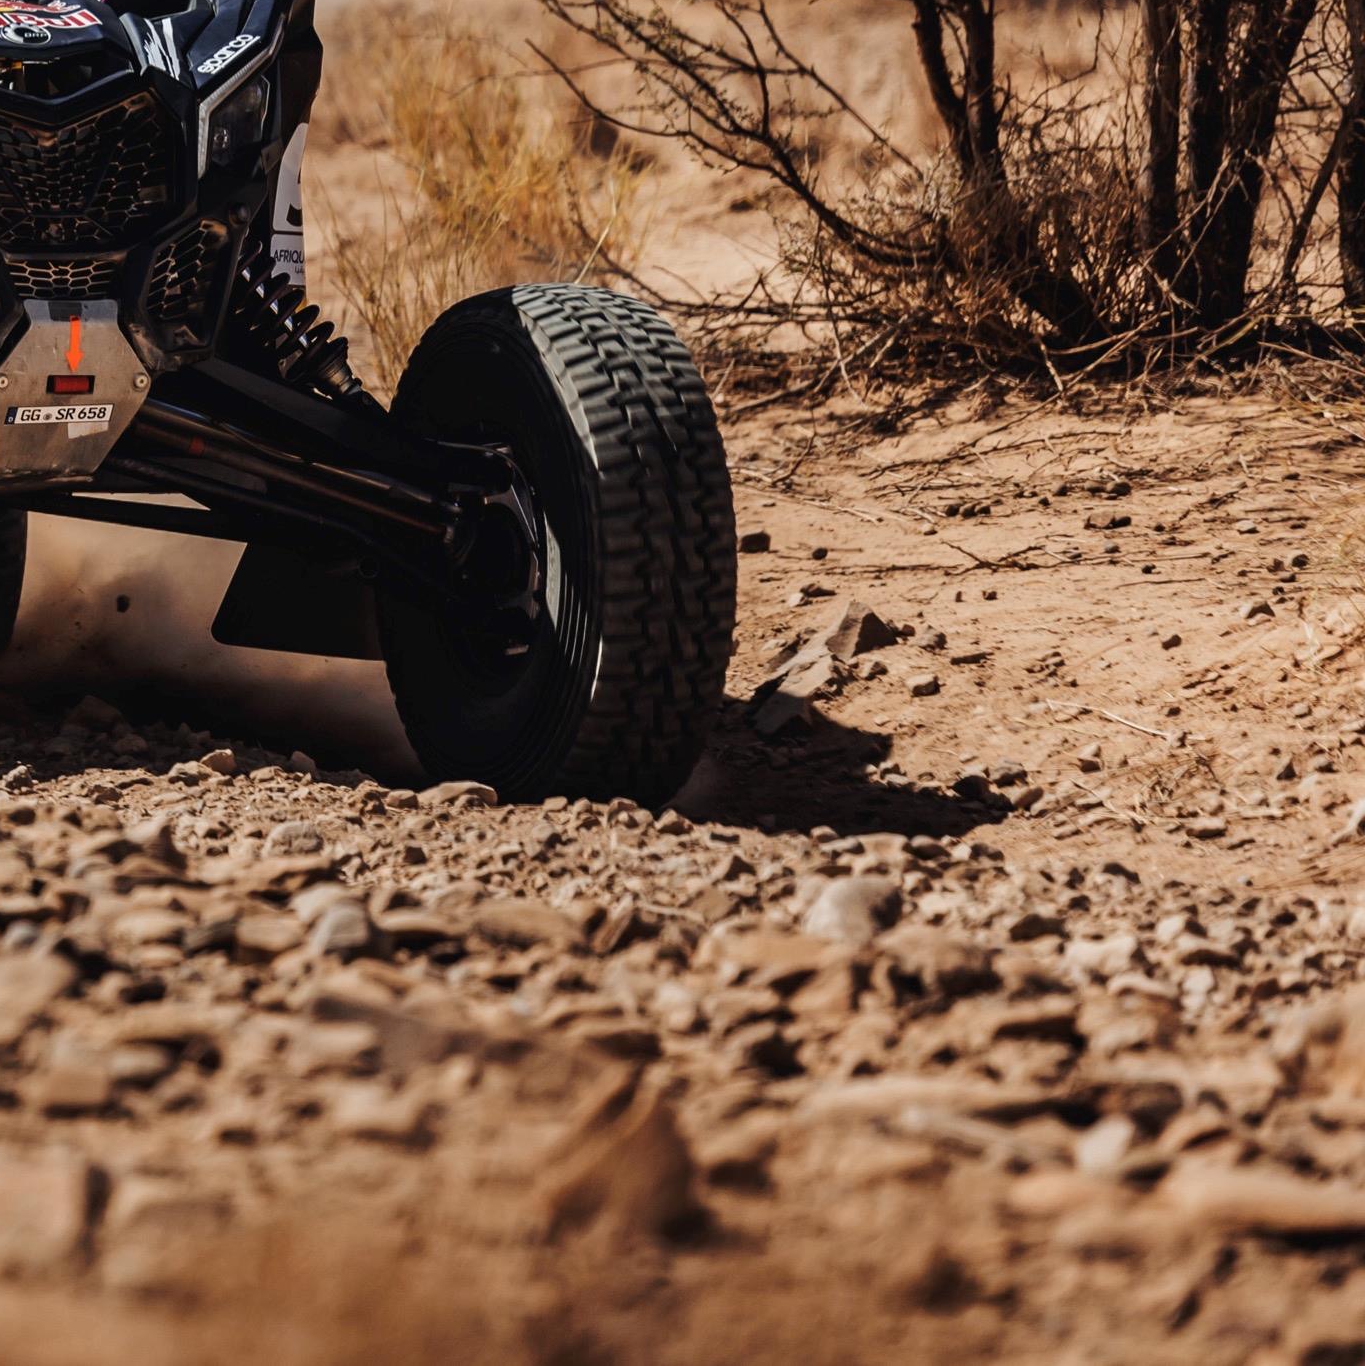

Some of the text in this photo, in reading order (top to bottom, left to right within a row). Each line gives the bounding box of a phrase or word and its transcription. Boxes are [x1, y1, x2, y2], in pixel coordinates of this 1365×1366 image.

[3, 8, 103, 29] Bull
[197, 34, 261, 75] sparco
[20, 409, 41, 421] GG
[55, 408, 76, 420] SR
[77, 407, 107, 419] 658
